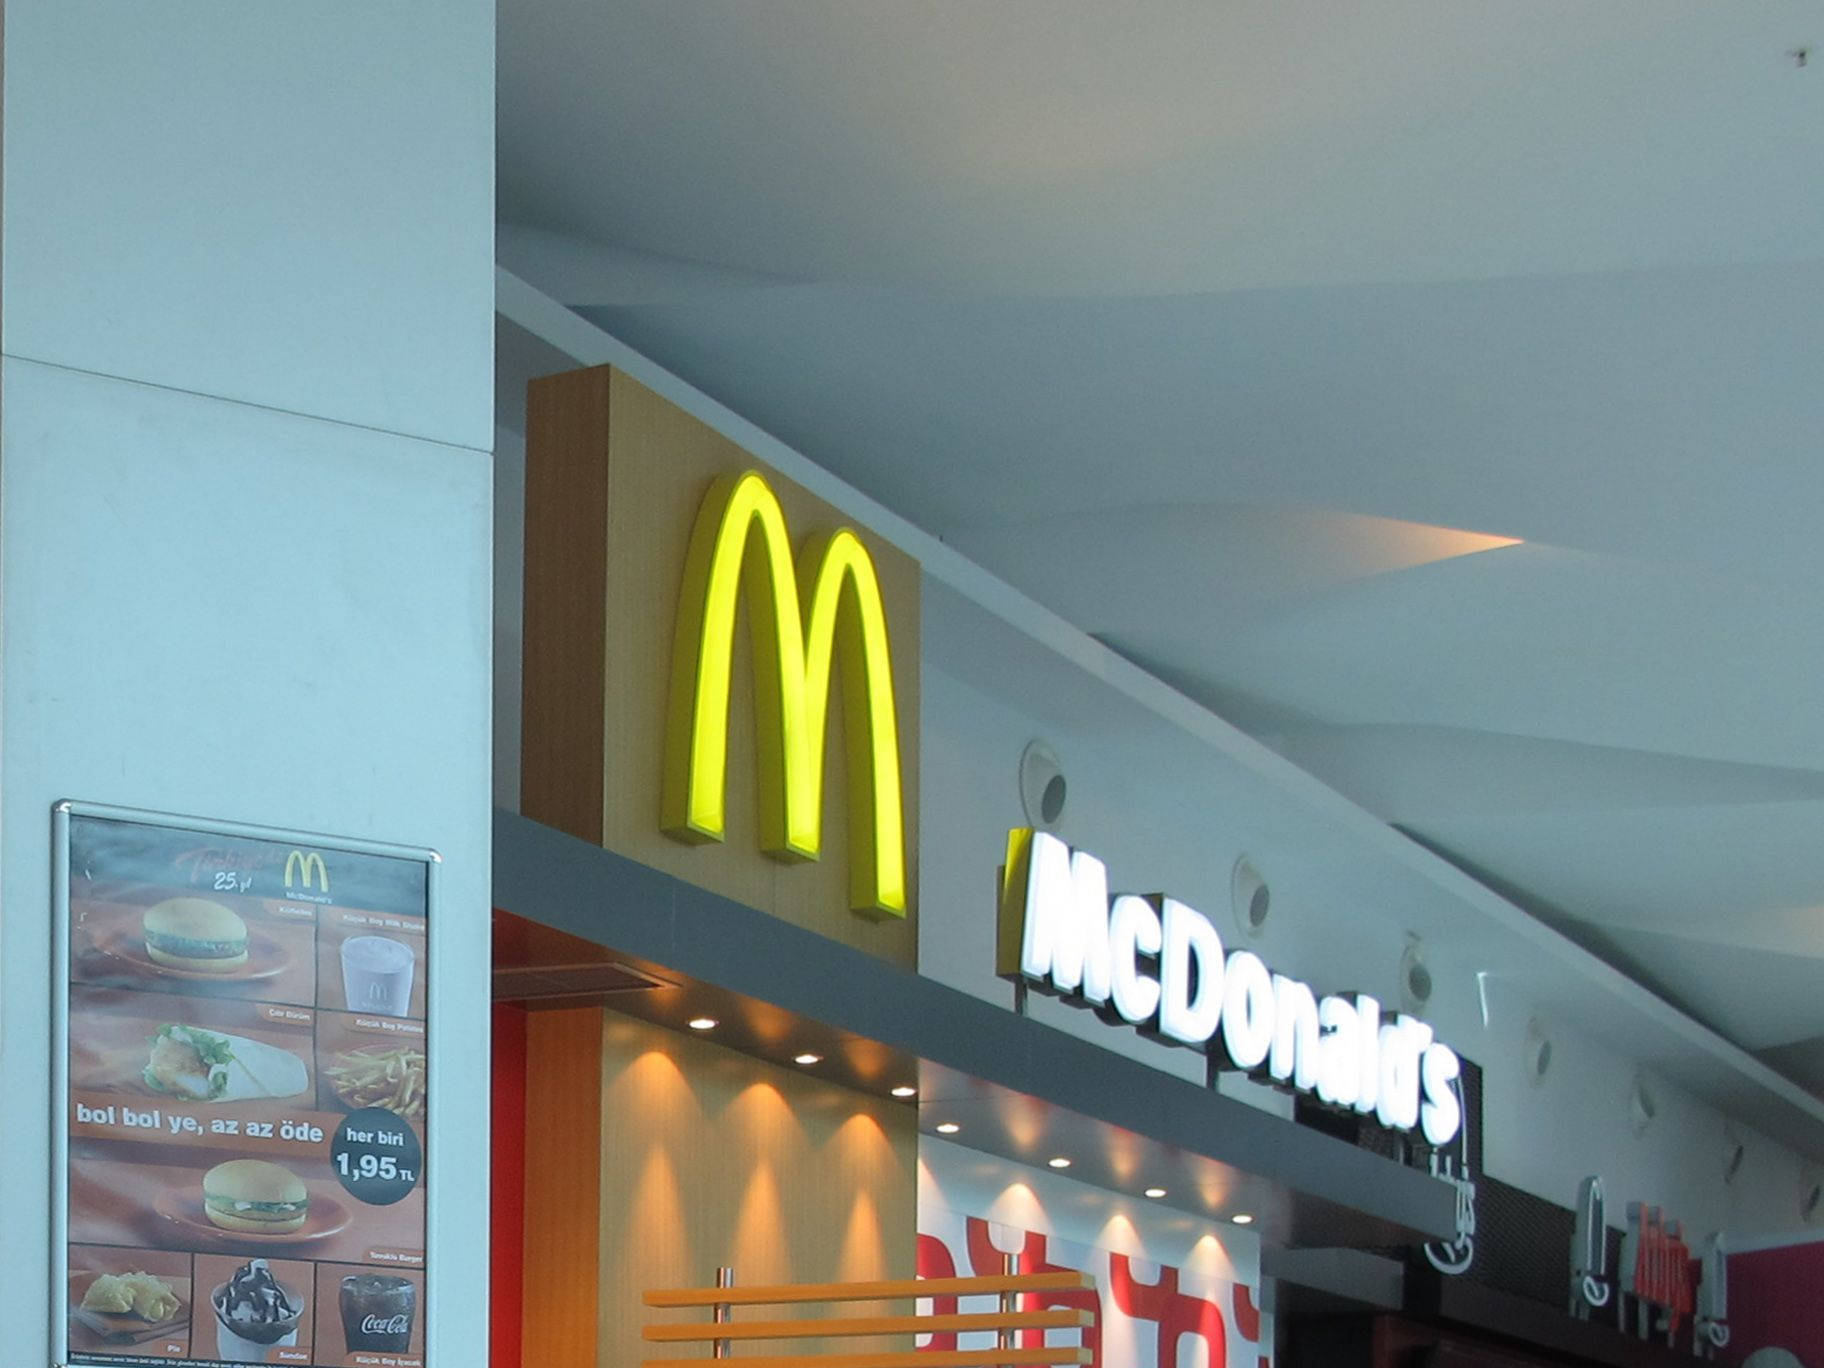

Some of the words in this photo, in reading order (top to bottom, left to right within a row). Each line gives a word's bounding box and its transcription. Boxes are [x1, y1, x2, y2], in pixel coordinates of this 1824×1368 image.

[1020, 830, 1462, 1147] McDonald's
[77, 1103, 114, 1124] bol
[123, 1106, 161, 1129] bol
[168, 1114, 203, 1135] ye,
[211, 1118, 239, 1135] az
[246, 1122, 273, 1138] az
[280, 1120, 323, 1143] öde
[346, 1127, 373, 1145] her
[377, 1129, 404, 1147] biri
[337, 1152, 398, 1182] 1,95
[400, 1168, 415, 1182] TL
